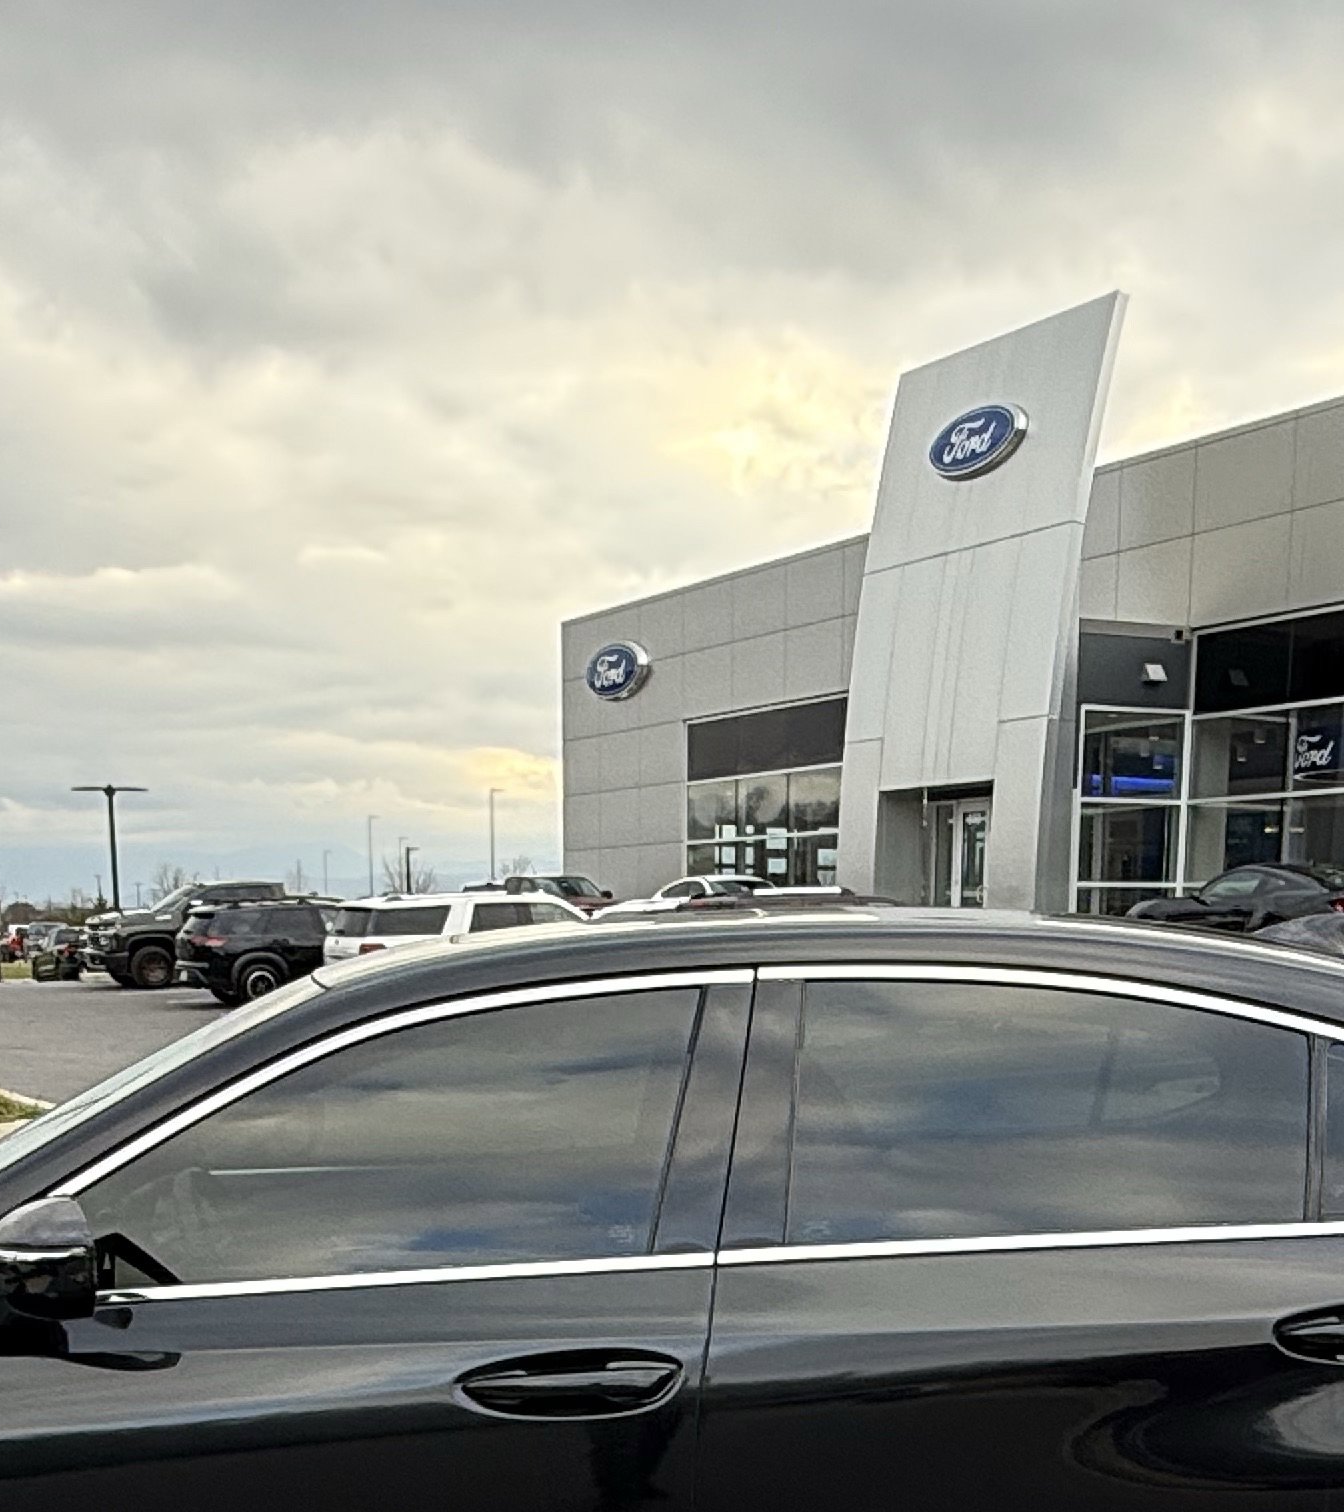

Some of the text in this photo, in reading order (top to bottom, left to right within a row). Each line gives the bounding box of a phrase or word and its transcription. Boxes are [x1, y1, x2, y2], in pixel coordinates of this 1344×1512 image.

[942, 417, 996, 464] Ford
[594, 654, 626, 688] Ford
[1295, 734, 1336, 769] Ford
